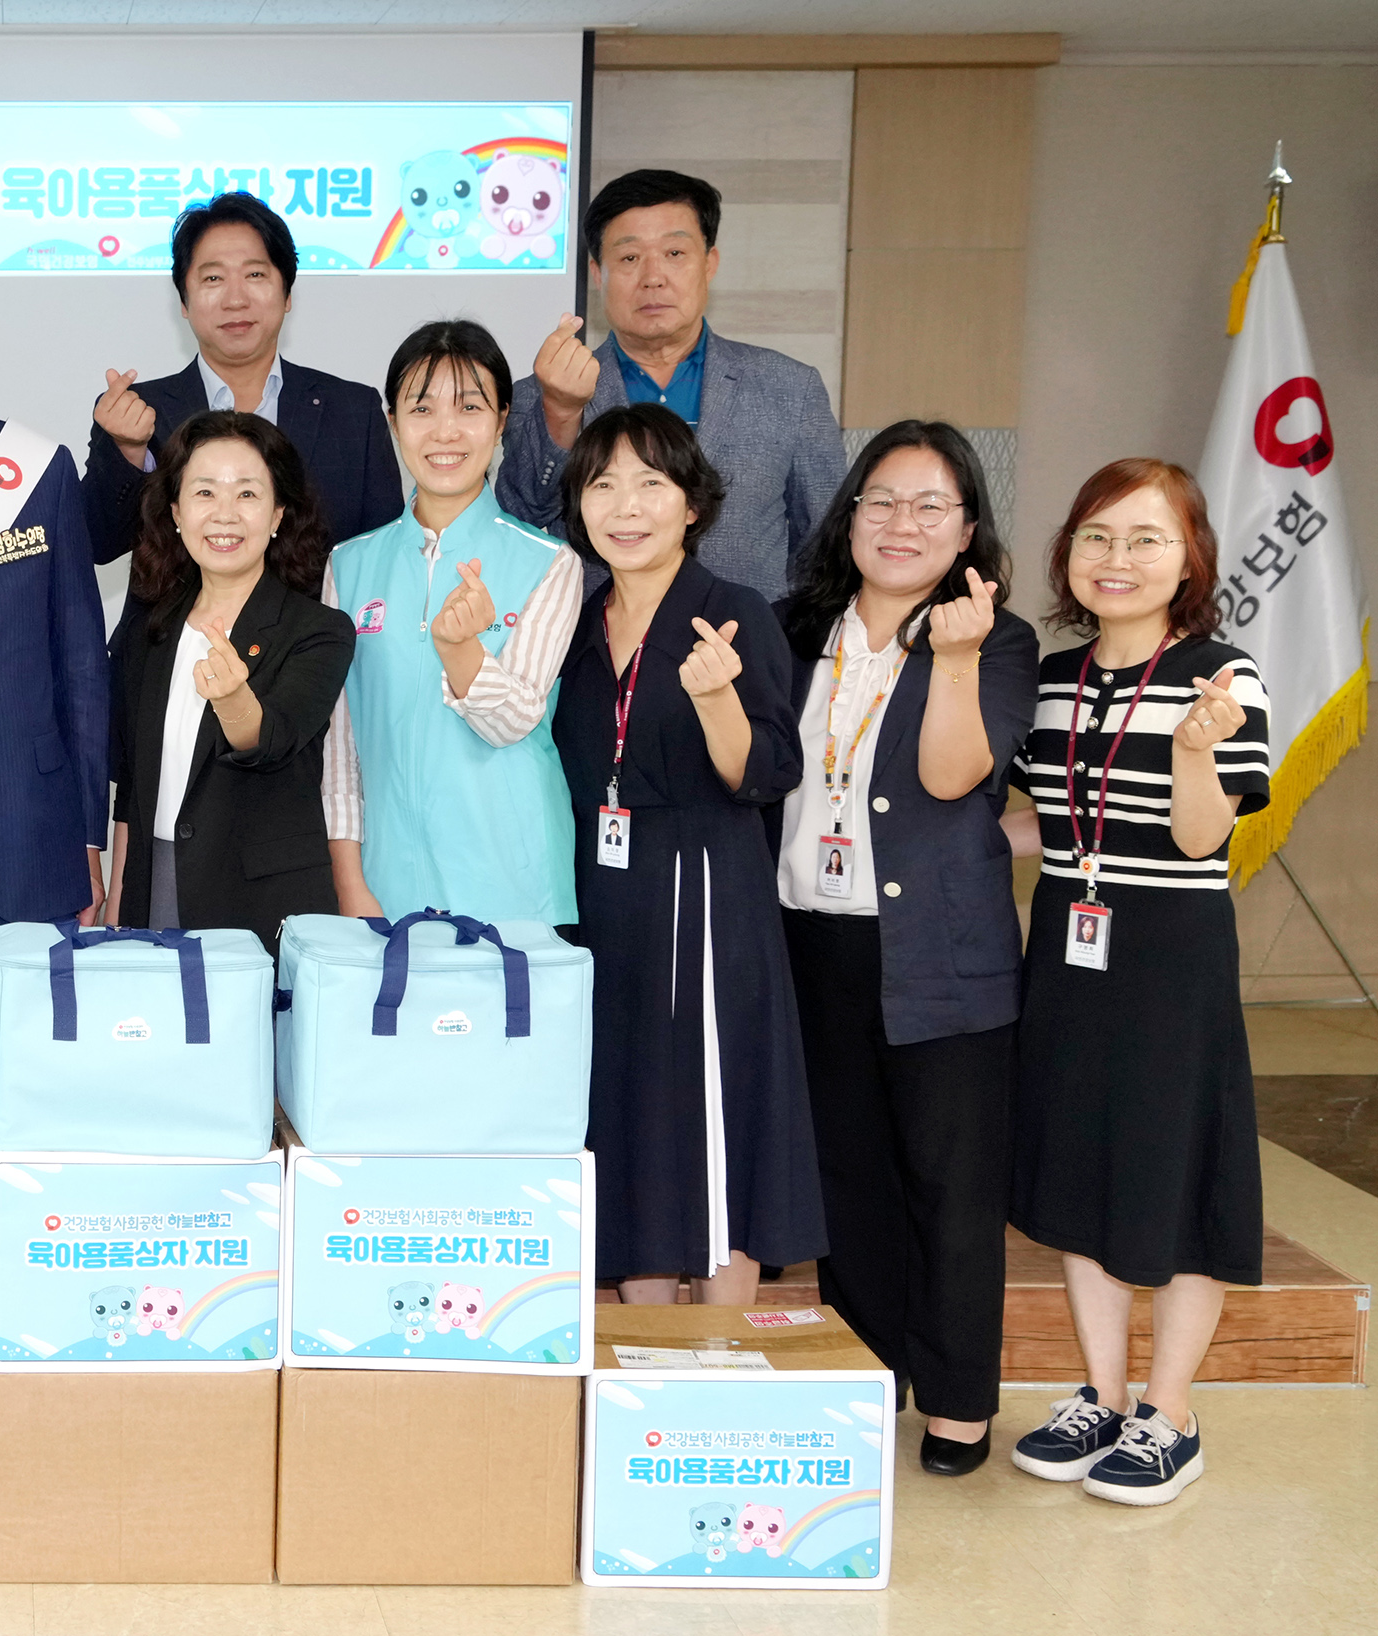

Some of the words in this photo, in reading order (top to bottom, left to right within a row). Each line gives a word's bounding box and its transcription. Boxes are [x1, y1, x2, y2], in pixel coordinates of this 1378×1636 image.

[1, 167, 273, 219] 육아용품상자
[285, 167, 373, 218] 지원
[1213, 490, 1328, 646] 강보험
[64, 1215, 111, 1231] 건강보험
[114, 1214, 163, 1231] 사회공헌
[168, 1211, 231, 1229] 하늘반창고
[362, 1209, 410, 1225] 건강보험
[413, 1209, 462, 1226] 사회공헌
[467, 1208, 533, 1226] 하늘반창고
[28, 1239, 189, 1269] 육아용품상자
[195, 1239, 248, 1266] 지원
[326, 1235, 489, 1264] 육아용품상자
[495, 1238, 550, 1266] 지원
[664, 1431, 712, 1447] 건강보험
[714, 1432, 764, 1447] 사회공헌
[769, 1430, 835, 1448] 하늘반창고
[628, 1457, 791, 1485] 육아용품상자
[797, 1458, 851, 1486] 지원
